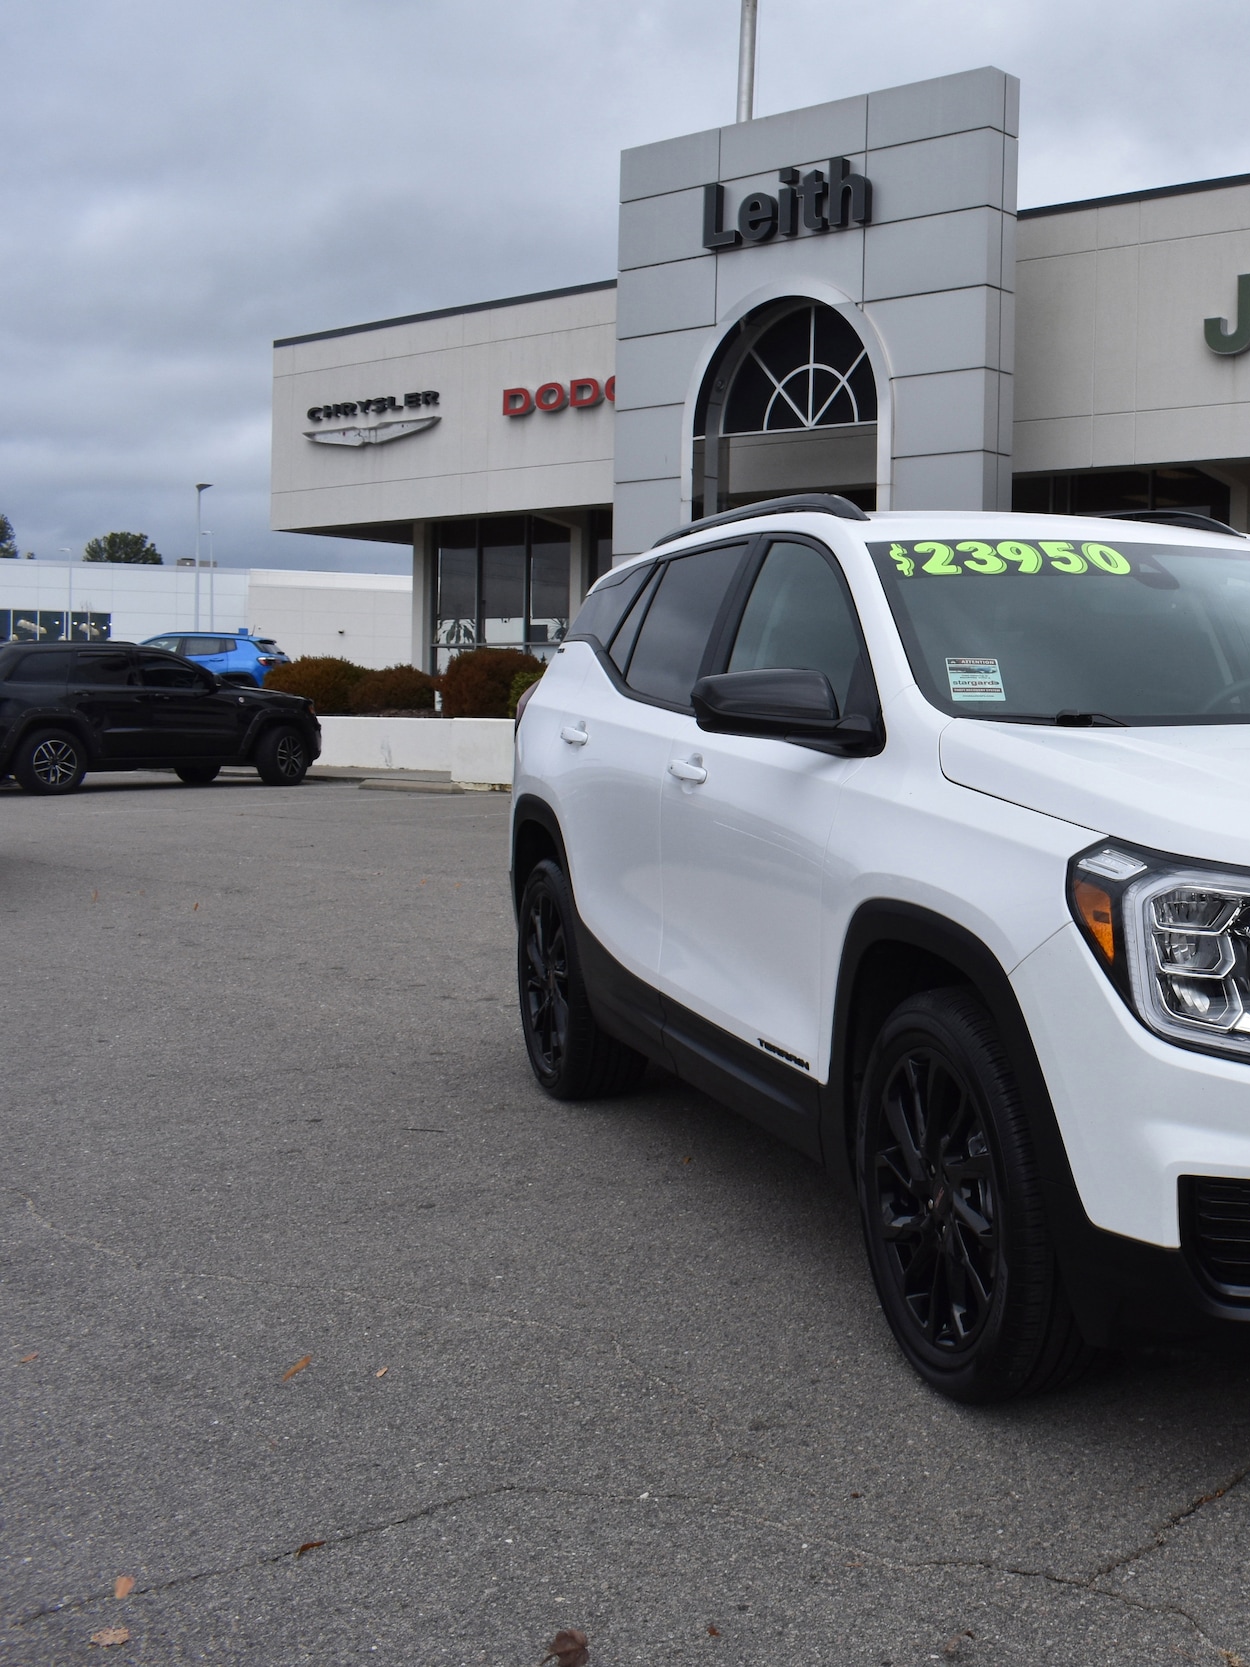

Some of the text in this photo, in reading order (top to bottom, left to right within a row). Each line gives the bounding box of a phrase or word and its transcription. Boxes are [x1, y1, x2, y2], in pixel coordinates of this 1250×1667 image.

[703, 156, 873, 249] Leith
[307, 390, 440, 422] CHRYSLER
[889, 541, 1131, 577] $23950
